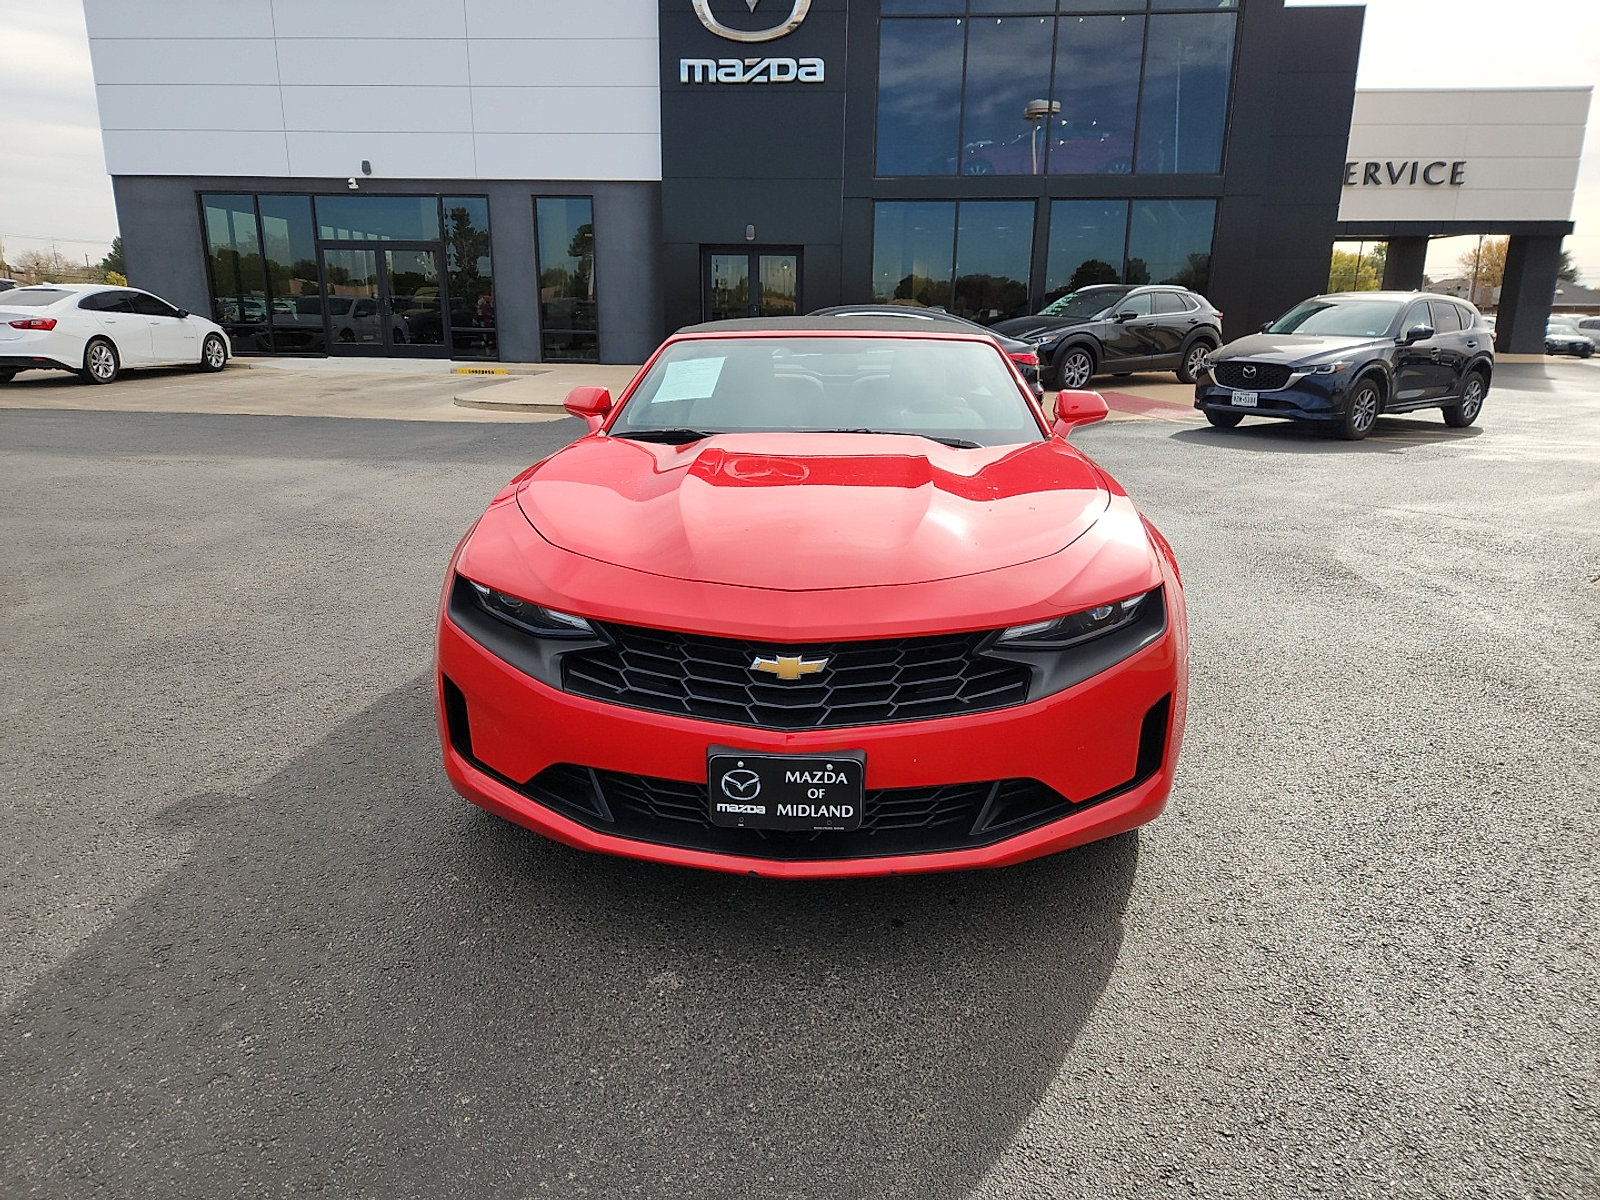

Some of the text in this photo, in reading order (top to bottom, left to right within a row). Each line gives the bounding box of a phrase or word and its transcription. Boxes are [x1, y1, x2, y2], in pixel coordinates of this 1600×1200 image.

[1343, 160, 1467, 186] ERVICE
[785, 771, 848, 785] MAZDA
[807, 788, 826, 799] OF
[776, 804, 854, 818] MIDLAND
